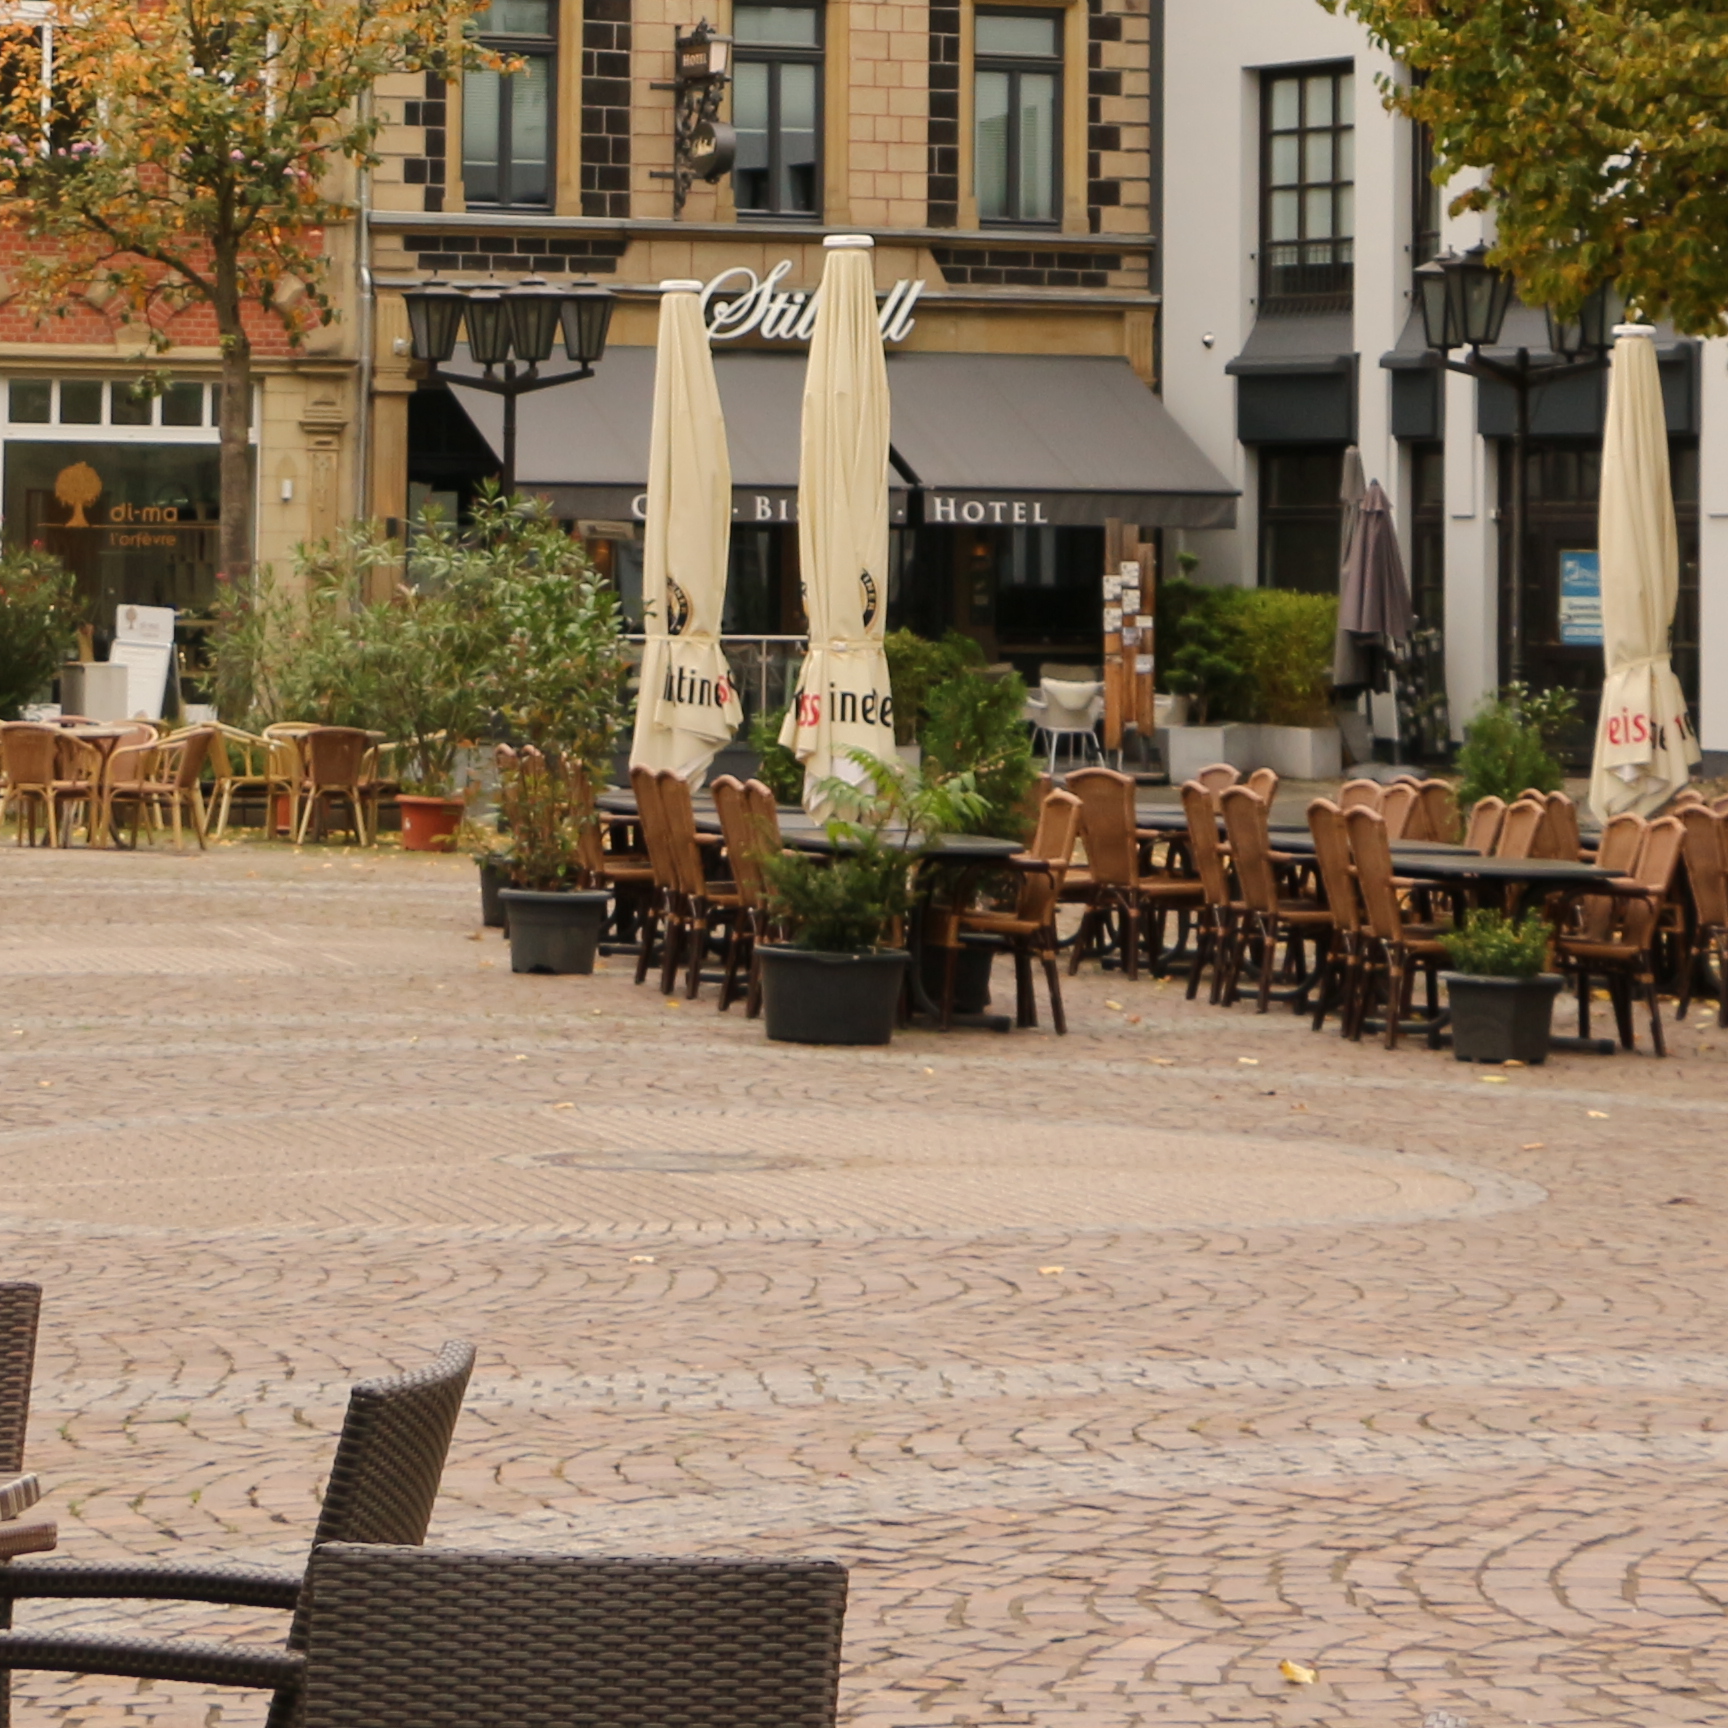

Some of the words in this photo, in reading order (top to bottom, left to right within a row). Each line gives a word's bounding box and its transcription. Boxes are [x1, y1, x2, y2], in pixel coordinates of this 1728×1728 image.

[702, 259, 927, 342] Stilll
[110, 503, 179, 523] di-ma
[933, 496, 1049, 524] HOTEL
